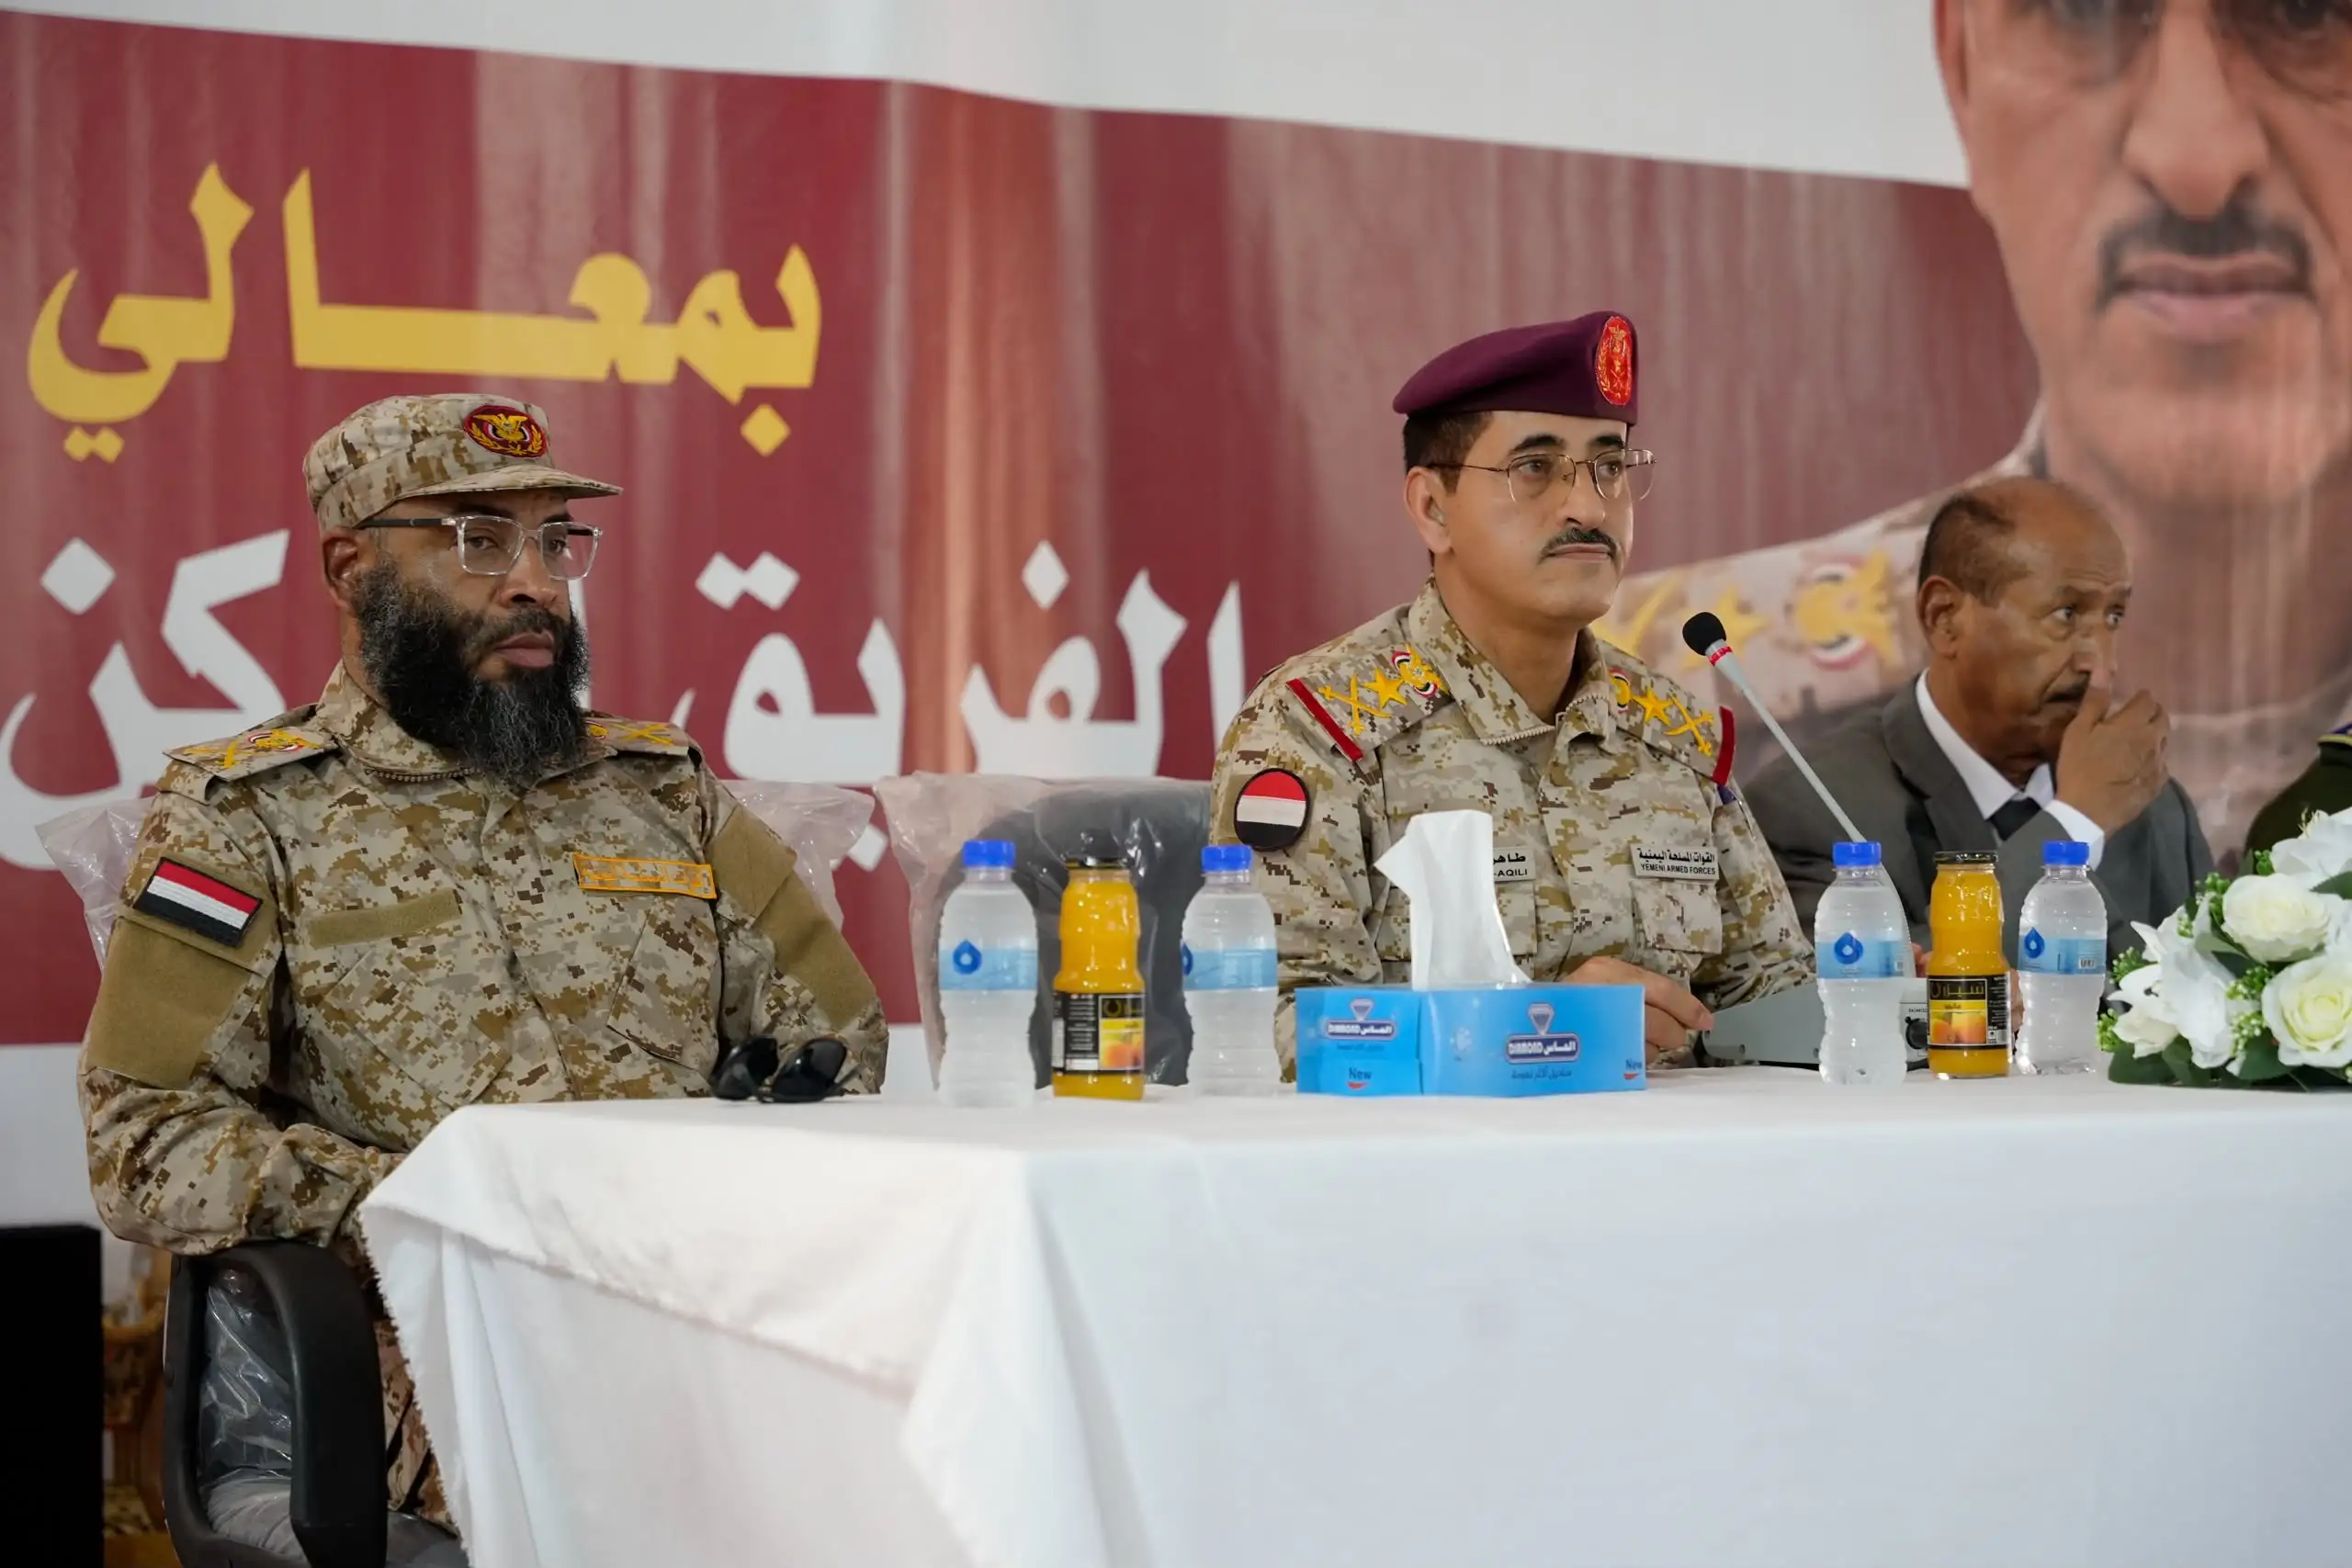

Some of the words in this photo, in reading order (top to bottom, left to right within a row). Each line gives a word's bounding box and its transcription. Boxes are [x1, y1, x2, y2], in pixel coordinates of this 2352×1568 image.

[27, 162, 822, 465] بمعالي
[1636, 847, 1668, 863] اليمنية
[1667, 849, 1692, 863] المسلحة
[1692, 852, 1715, 865] القوات
[1493, 867, 1528, 877] -AQILI
[1640, 863, 1666, 872] YEMENI
[1667, 864, 1689, 874] ARMED
[1690, 866, 1716, 875] FORCES
[1348, 1066, 1373, 1080] New
